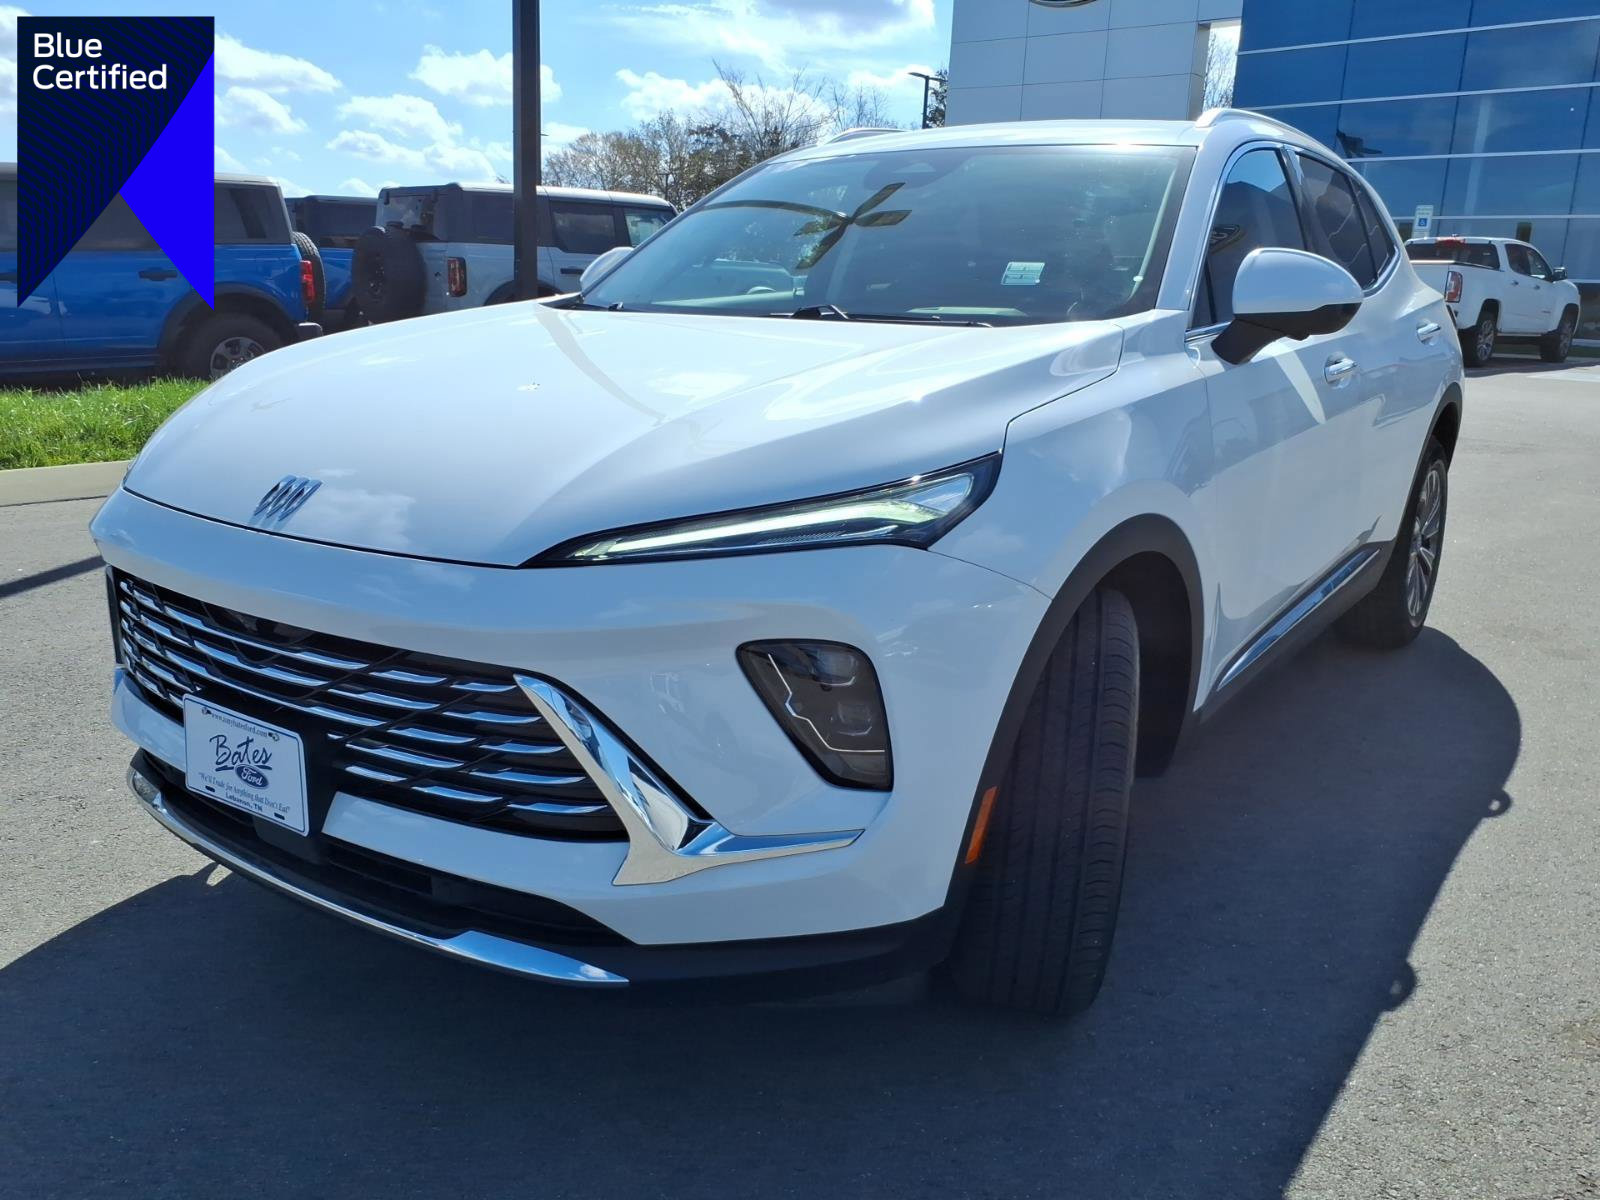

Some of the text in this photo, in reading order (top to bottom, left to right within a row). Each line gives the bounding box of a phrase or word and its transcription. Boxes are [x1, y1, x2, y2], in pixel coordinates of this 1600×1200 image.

[209, 734, 273, 766] Bates
[241, 766, 264, 786] Ford
[254, 803, 263, 812] TN
